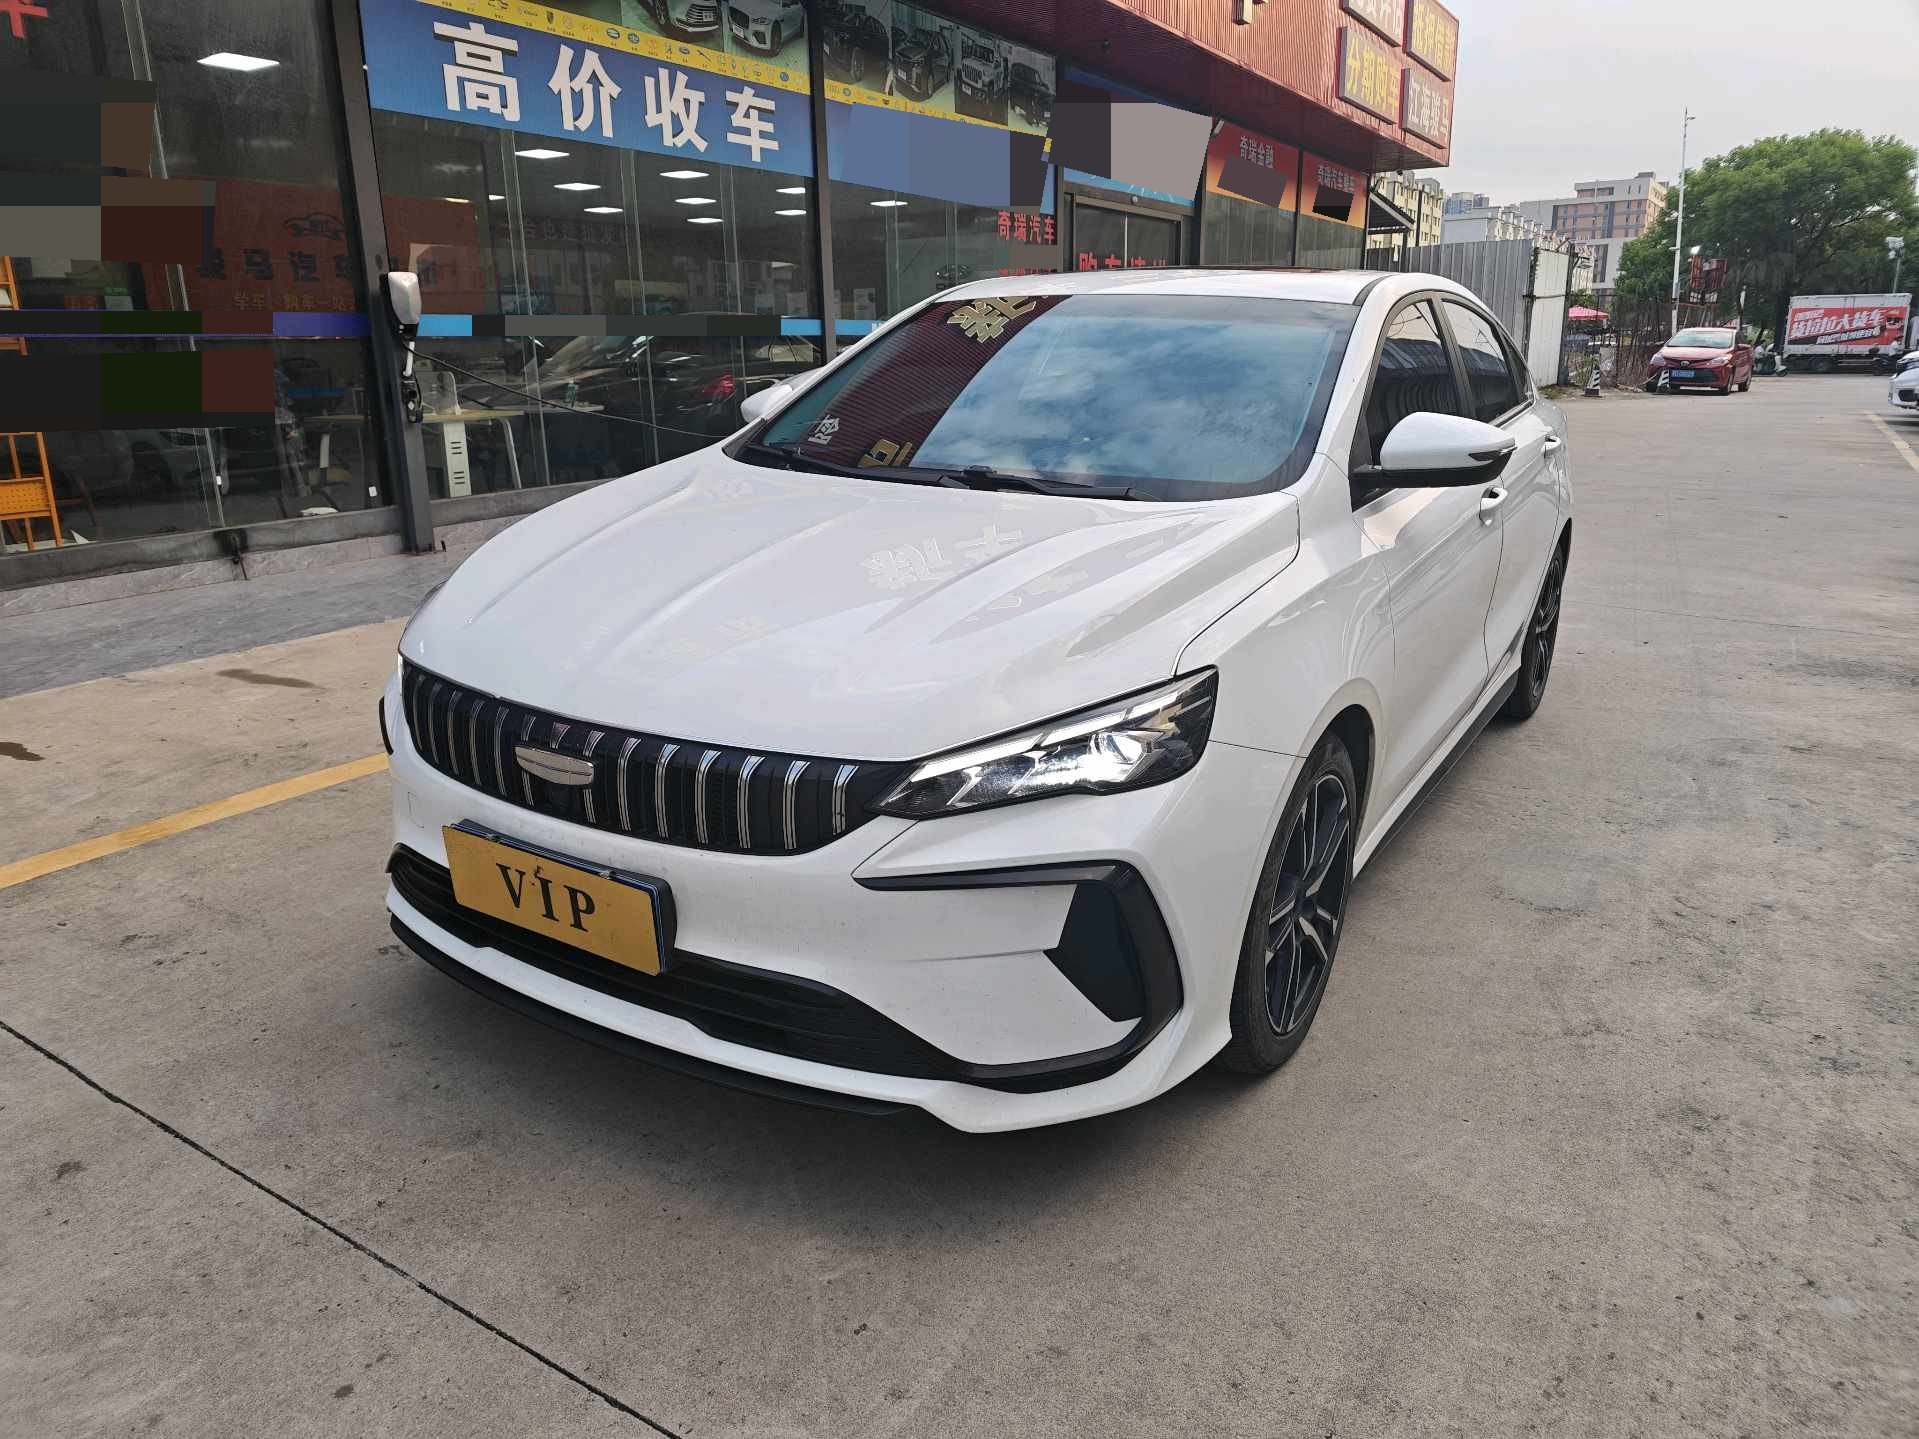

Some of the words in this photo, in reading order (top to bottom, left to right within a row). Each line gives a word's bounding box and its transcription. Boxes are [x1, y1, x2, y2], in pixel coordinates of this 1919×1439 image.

[433, 22, 779, 161] 高价收车
[998, 210, 1055, 244] 奇瑞汽车
[496, 863, 595, 932] VIP
